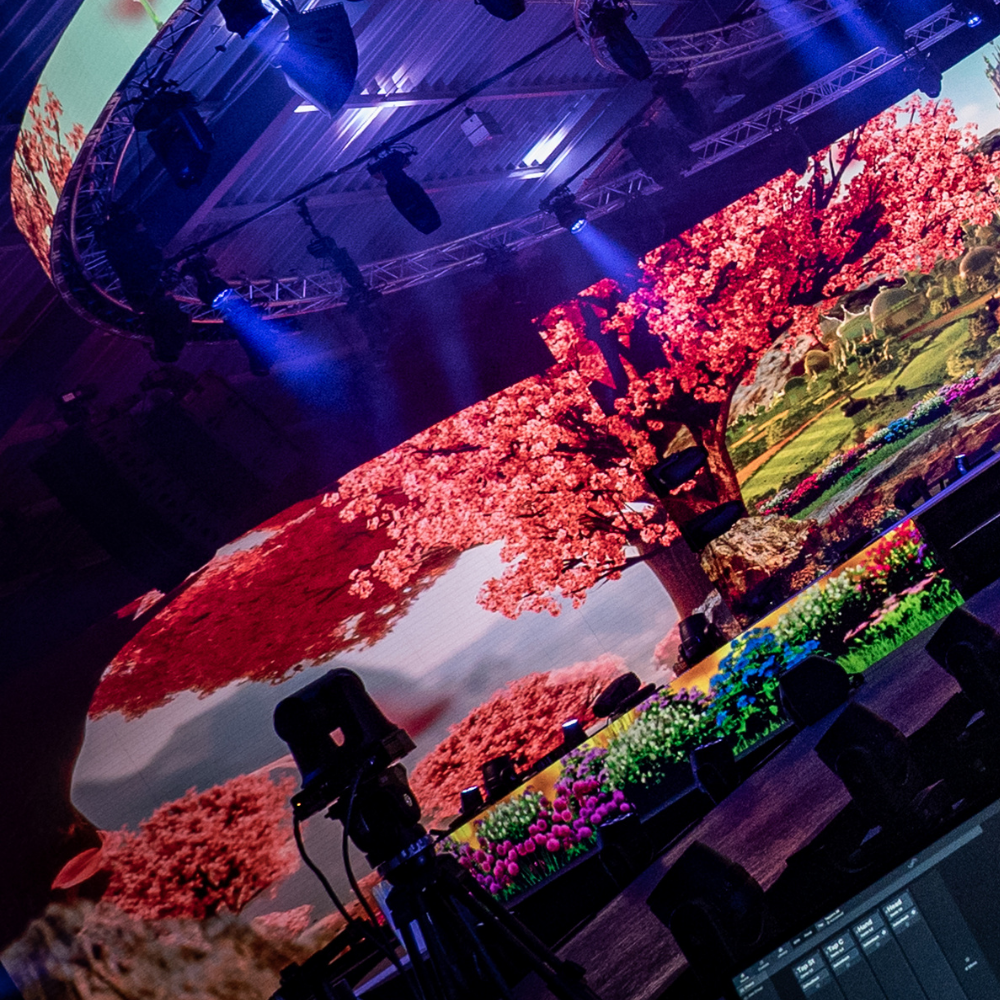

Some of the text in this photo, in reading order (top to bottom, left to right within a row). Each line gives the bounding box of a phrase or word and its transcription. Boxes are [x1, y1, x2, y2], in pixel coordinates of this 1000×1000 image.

[887, 899, 903, 912] Head
[858, 919, 873, 931] Hand
[827, 942, 839, 952] Tap
[797, 963, 808, 973] Tap
